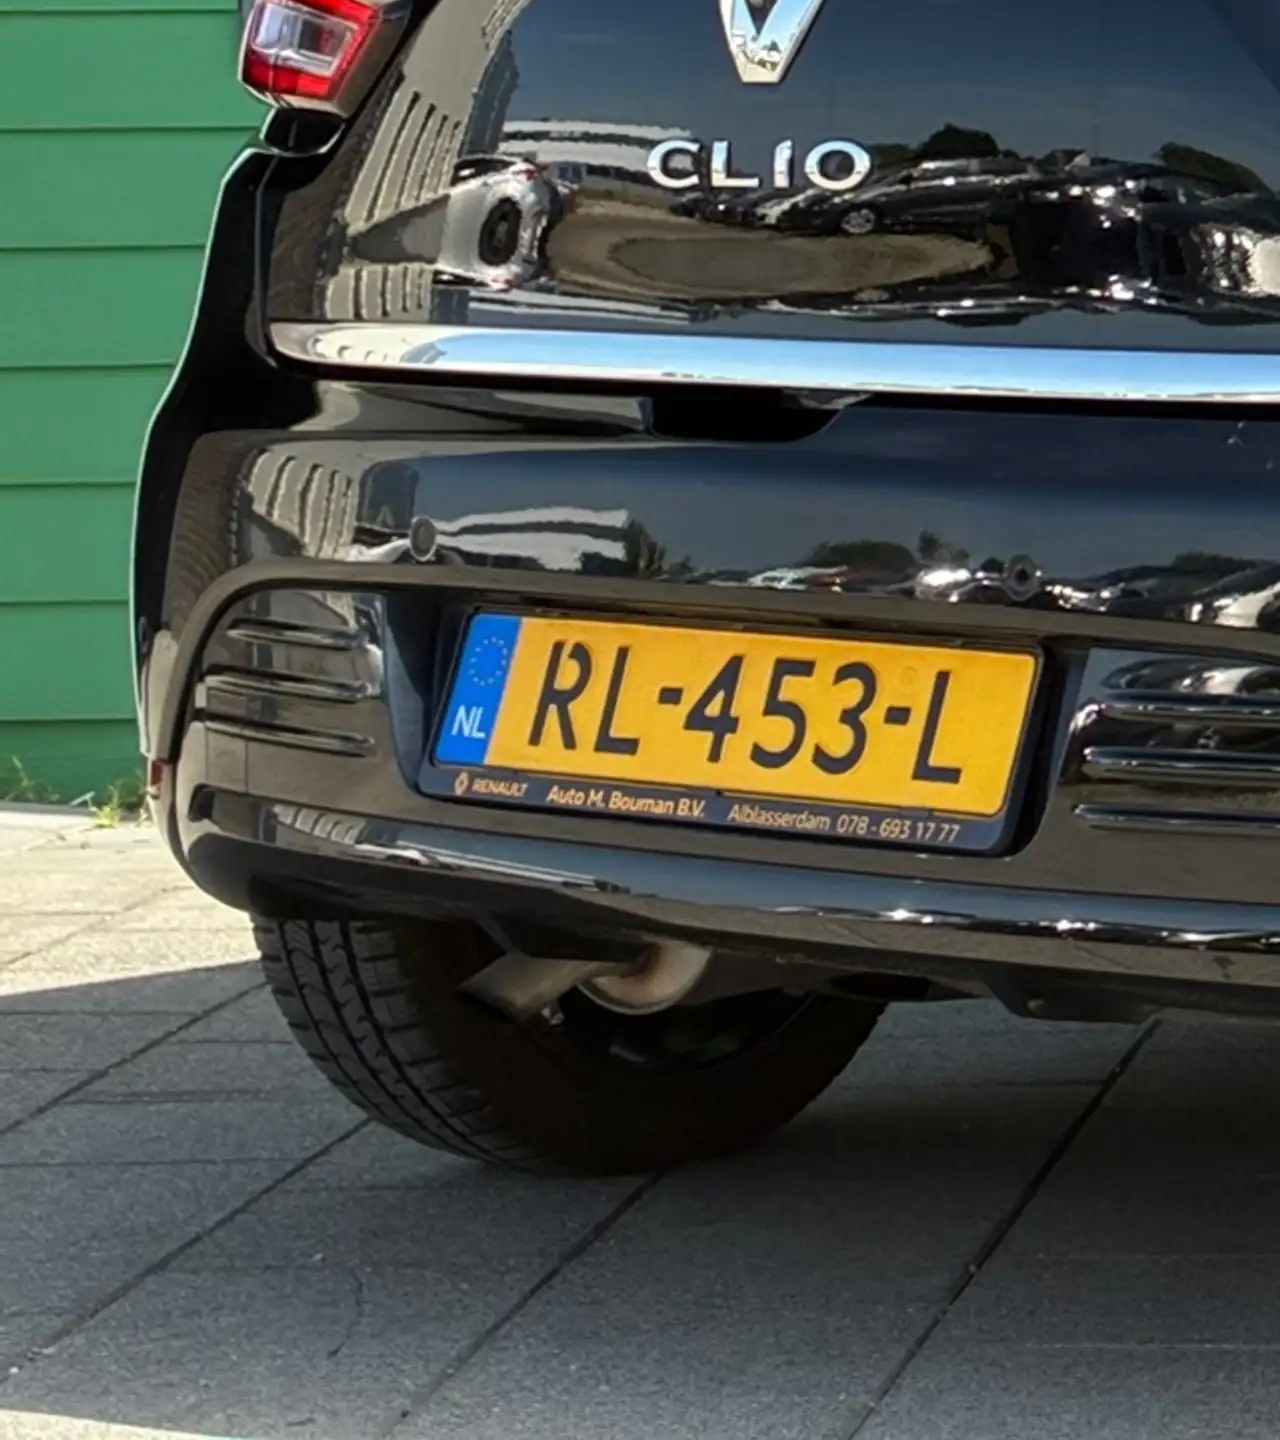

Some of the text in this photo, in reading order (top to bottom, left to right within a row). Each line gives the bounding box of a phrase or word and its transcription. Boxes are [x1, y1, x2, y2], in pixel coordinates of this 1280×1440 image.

[647, 140, 871, 191] CLIO
[451, 704, 486, 739] NL
[528, 640, 963, 784] RL-453-L
[472, 778, 529, 798] RENAULT
[546, 785, 705, 818] Auto M. Bouman B.V.
[727, 803, 832, 830] Alblasserdam
